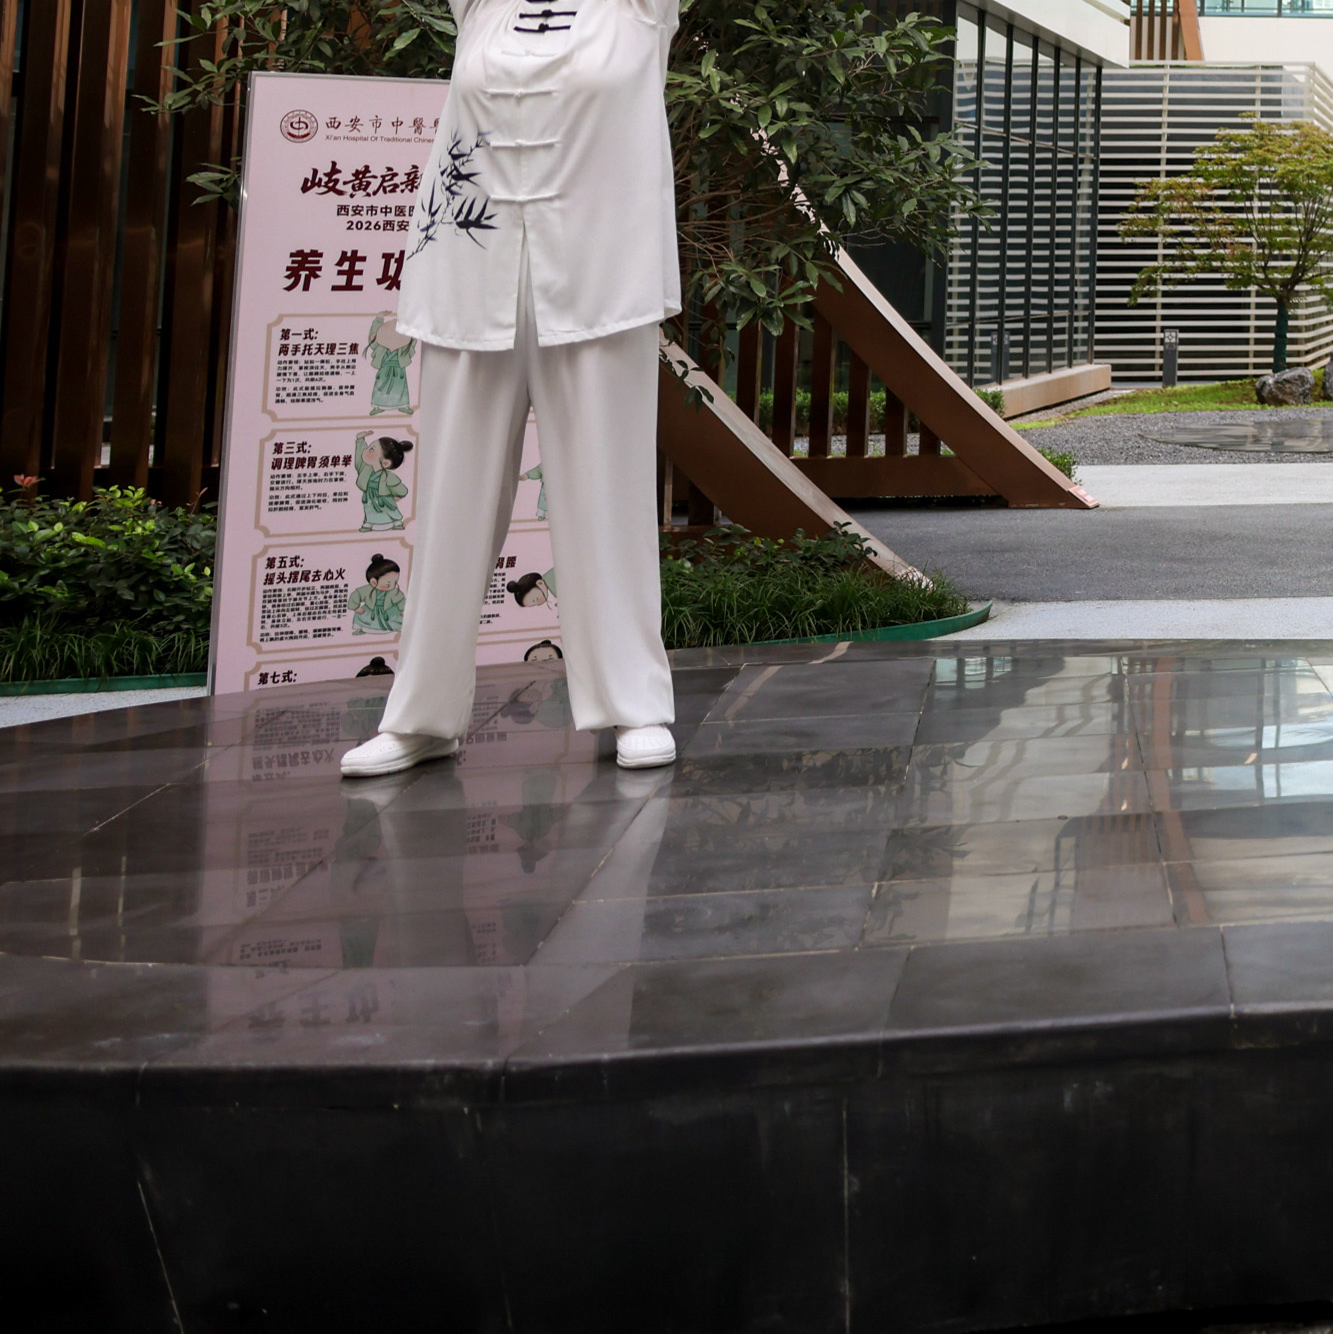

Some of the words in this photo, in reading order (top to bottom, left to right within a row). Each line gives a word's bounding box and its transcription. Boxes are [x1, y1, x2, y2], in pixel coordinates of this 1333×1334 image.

[278, 342, 360, 357] 两手托天理三焦
[271, 454, 352, 470] 调理脾胃须单举
[263, 567, 346, 586] 摇头摆尾去心火
